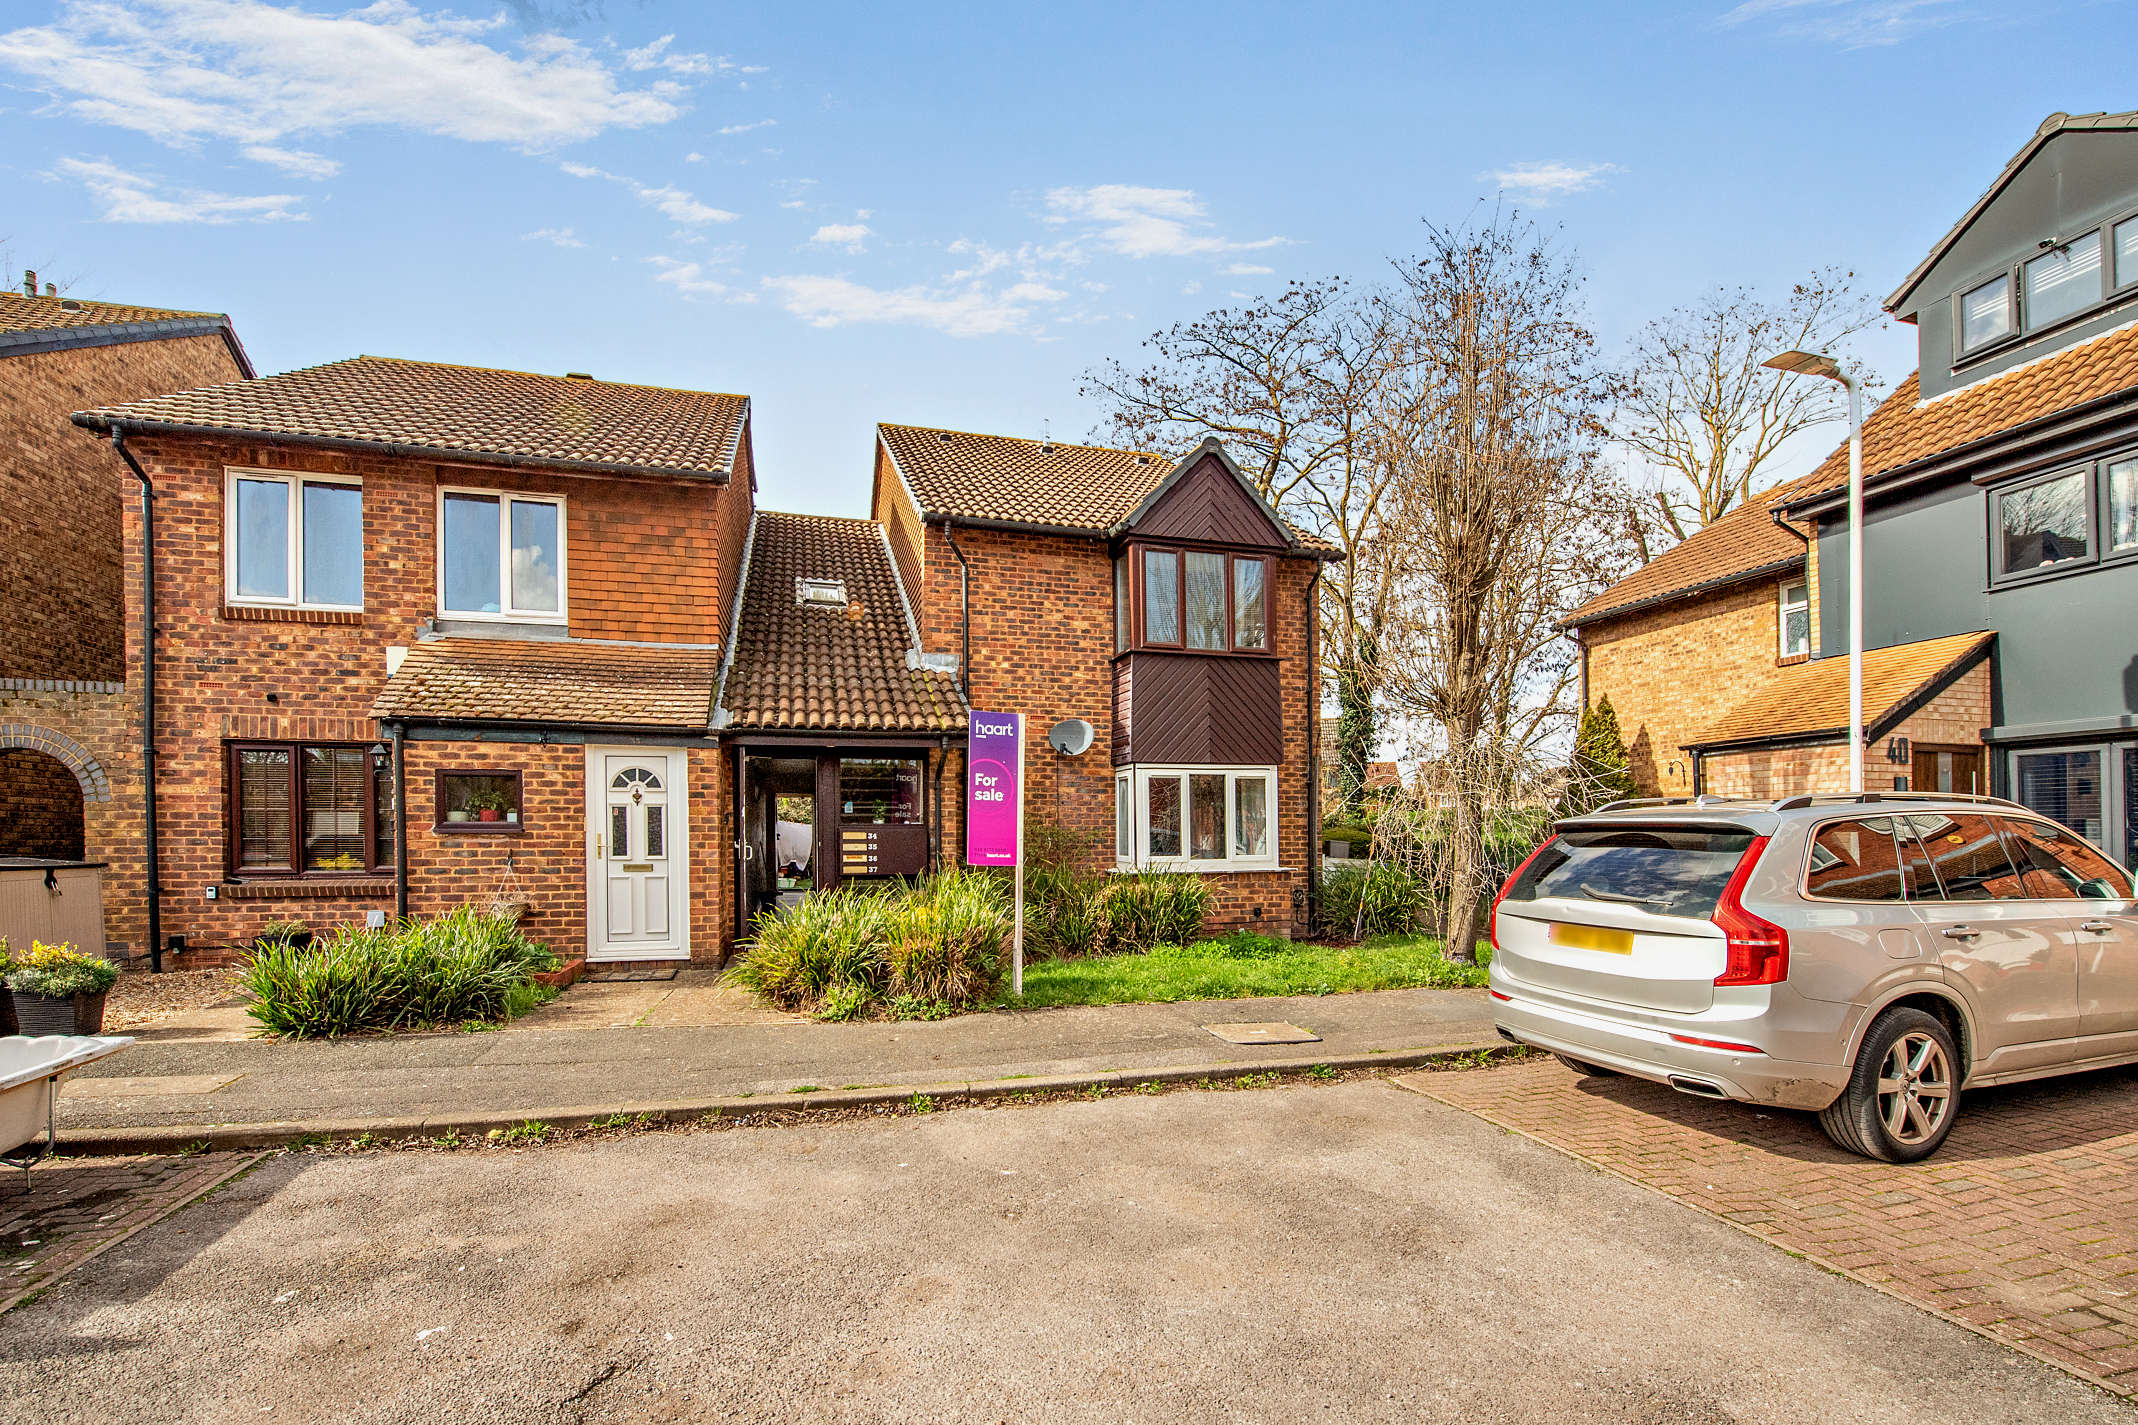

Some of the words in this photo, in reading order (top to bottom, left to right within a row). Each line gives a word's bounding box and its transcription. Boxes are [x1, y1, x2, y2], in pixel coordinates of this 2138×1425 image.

[975, 720, 1013, 738] haart
[1888, 736, 1909, 764] 40
[974, 773, 998, 787] For
[974, 788, 1003, 801] sale
